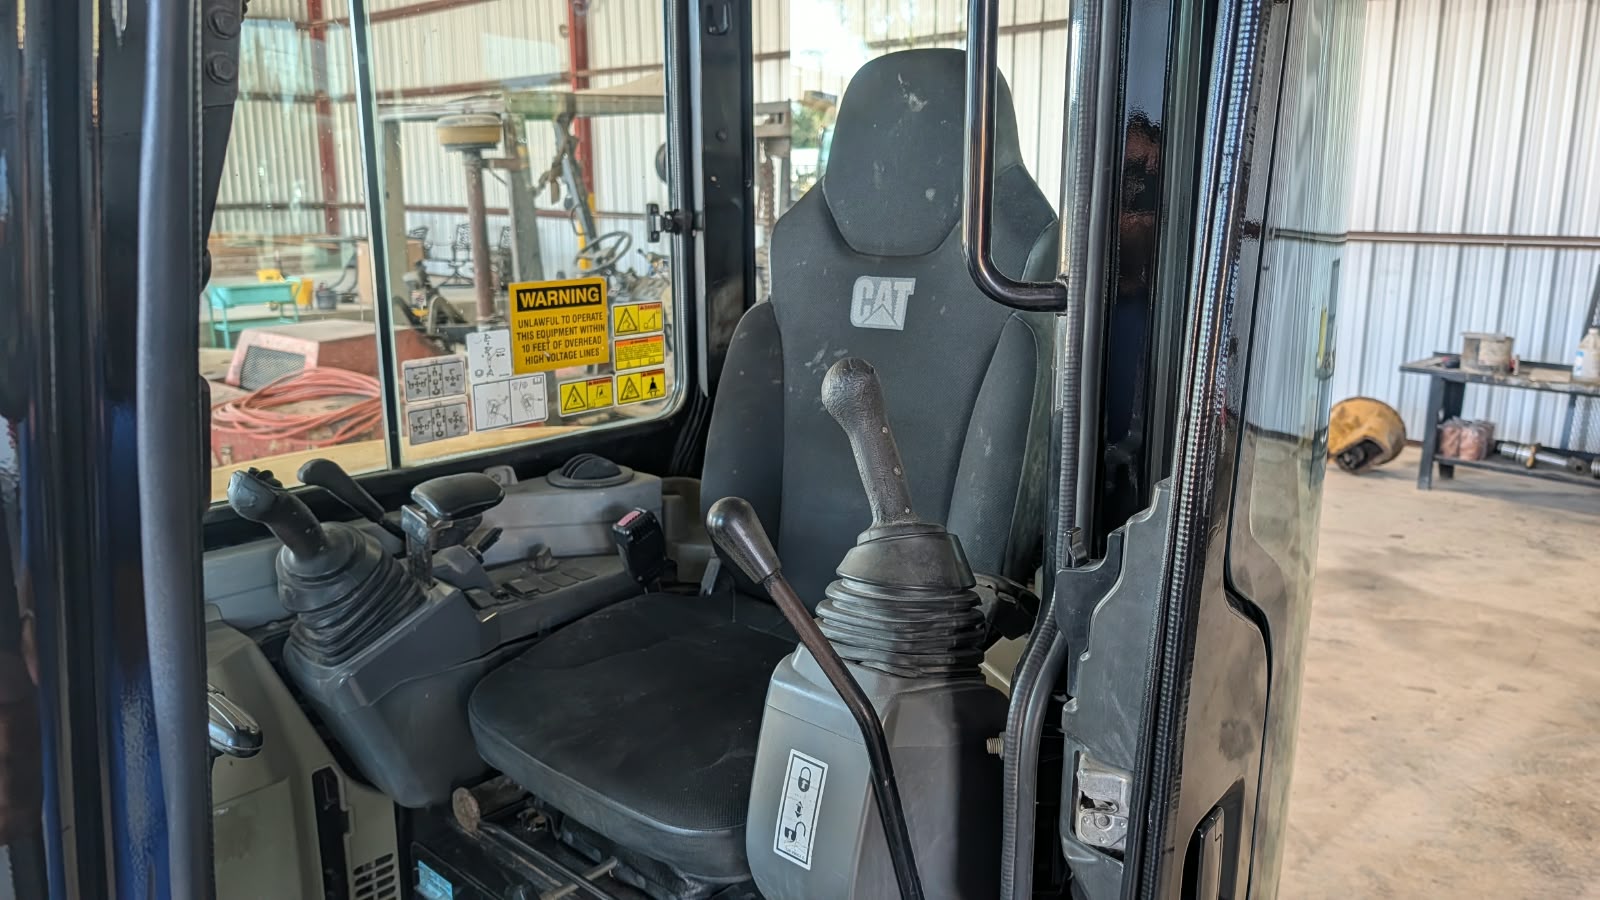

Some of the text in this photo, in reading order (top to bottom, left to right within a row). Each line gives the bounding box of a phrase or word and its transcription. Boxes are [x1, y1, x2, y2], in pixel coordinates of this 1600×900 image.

[519, 287, 600, 308] WARNING
[850, 276, 916, 330] CAT
[518, 312, 603, 328] UNLAWFUL TO OPERATE
[517, 324, 606, 342] THIS EQUIPMENT WITHIN
[522, 336, 602, 353] 10 FEET OF OVERHEAD
[526, 348, 600, 366] HIGH VOLTAGE LINES
